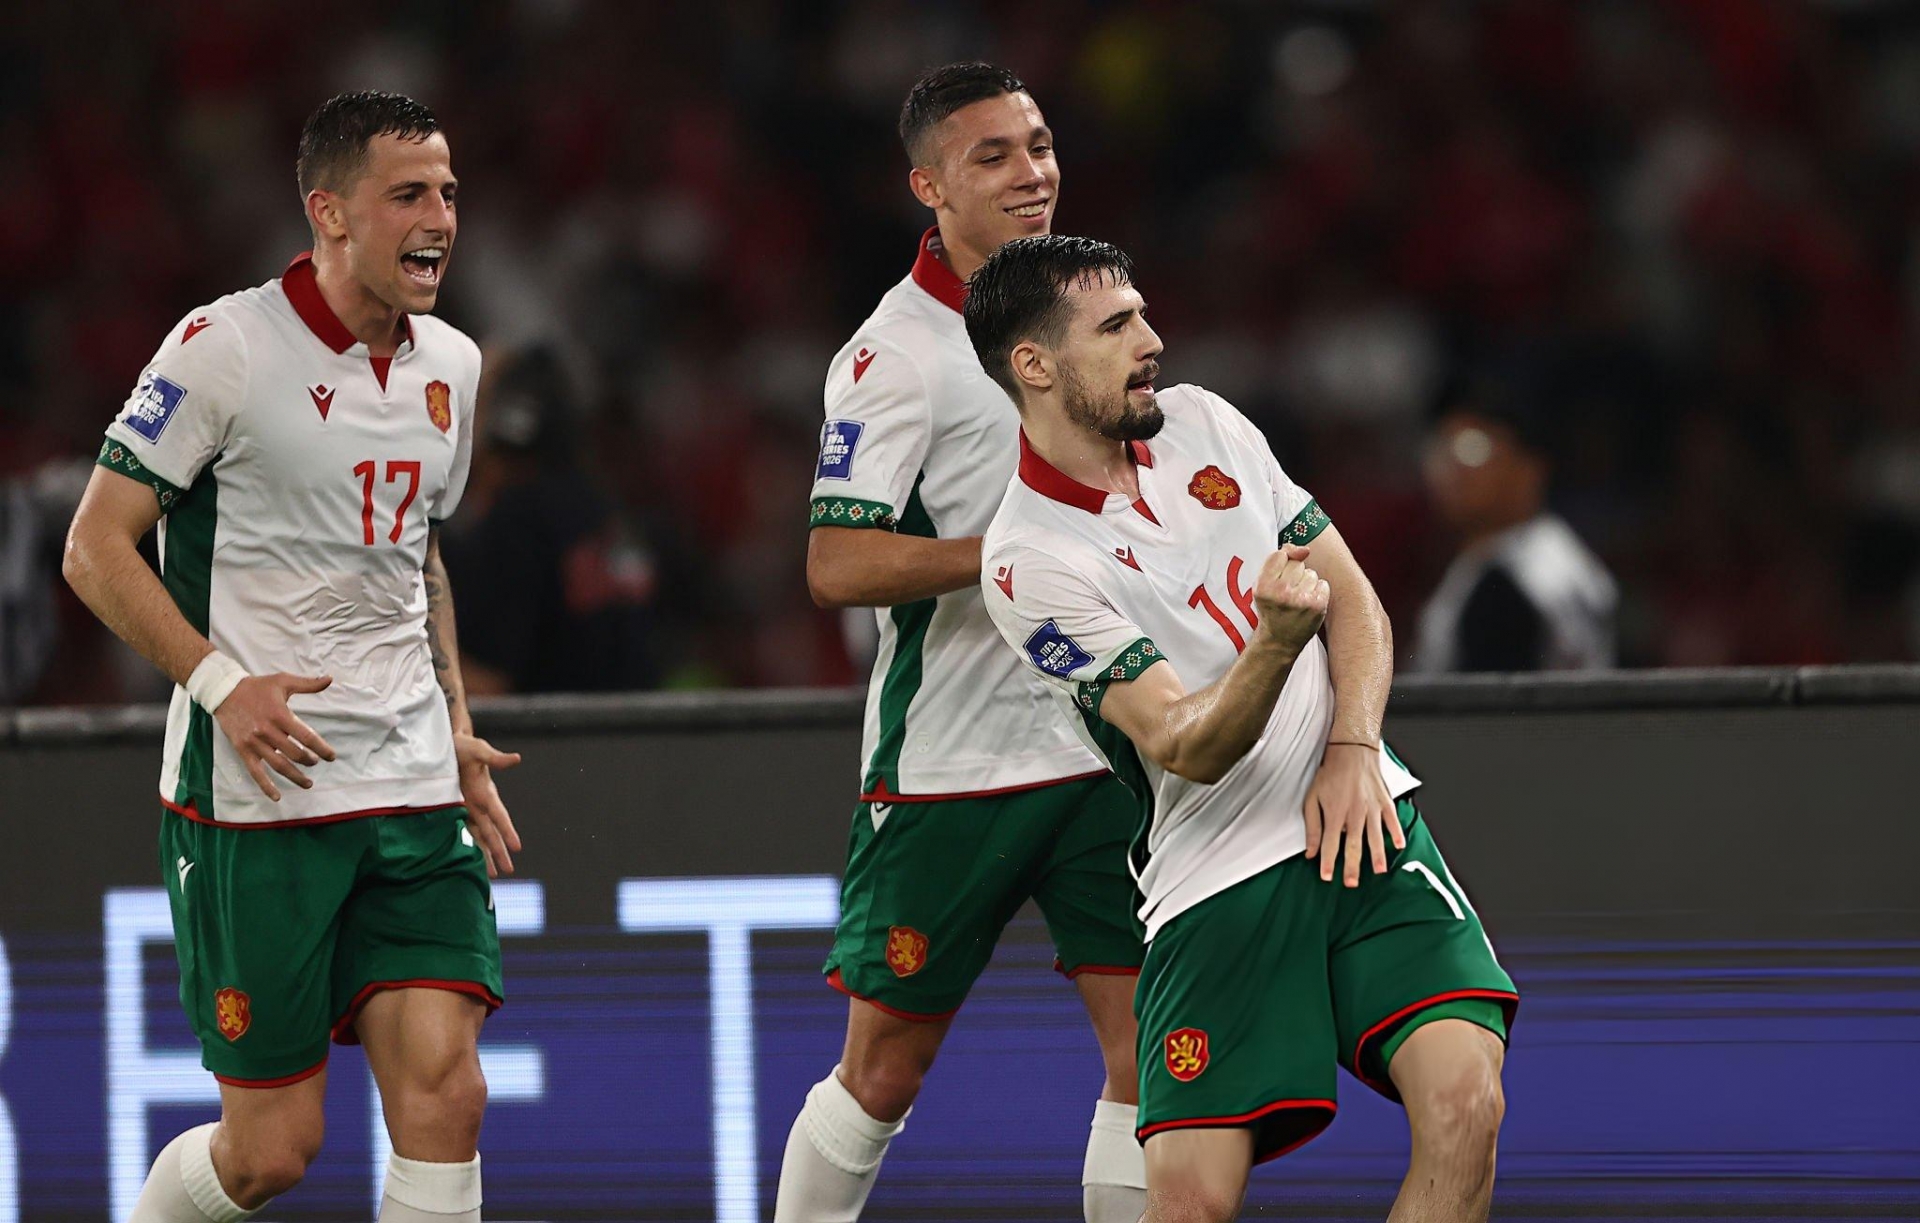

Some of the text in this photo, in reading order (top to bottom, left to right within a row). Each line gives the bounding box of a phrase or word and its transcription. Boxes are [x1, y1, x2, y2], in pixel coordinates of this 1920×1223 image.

[823, 444, 849, 456] SERIES
[822, 455, 842, 466] 2026
[353, 460, 421, 546] 17
[1040, 641, 1057, 658] FIFA
[1041, 642, 1069, 668] SERIES
[1050, 652, 1074, 671] 2026
